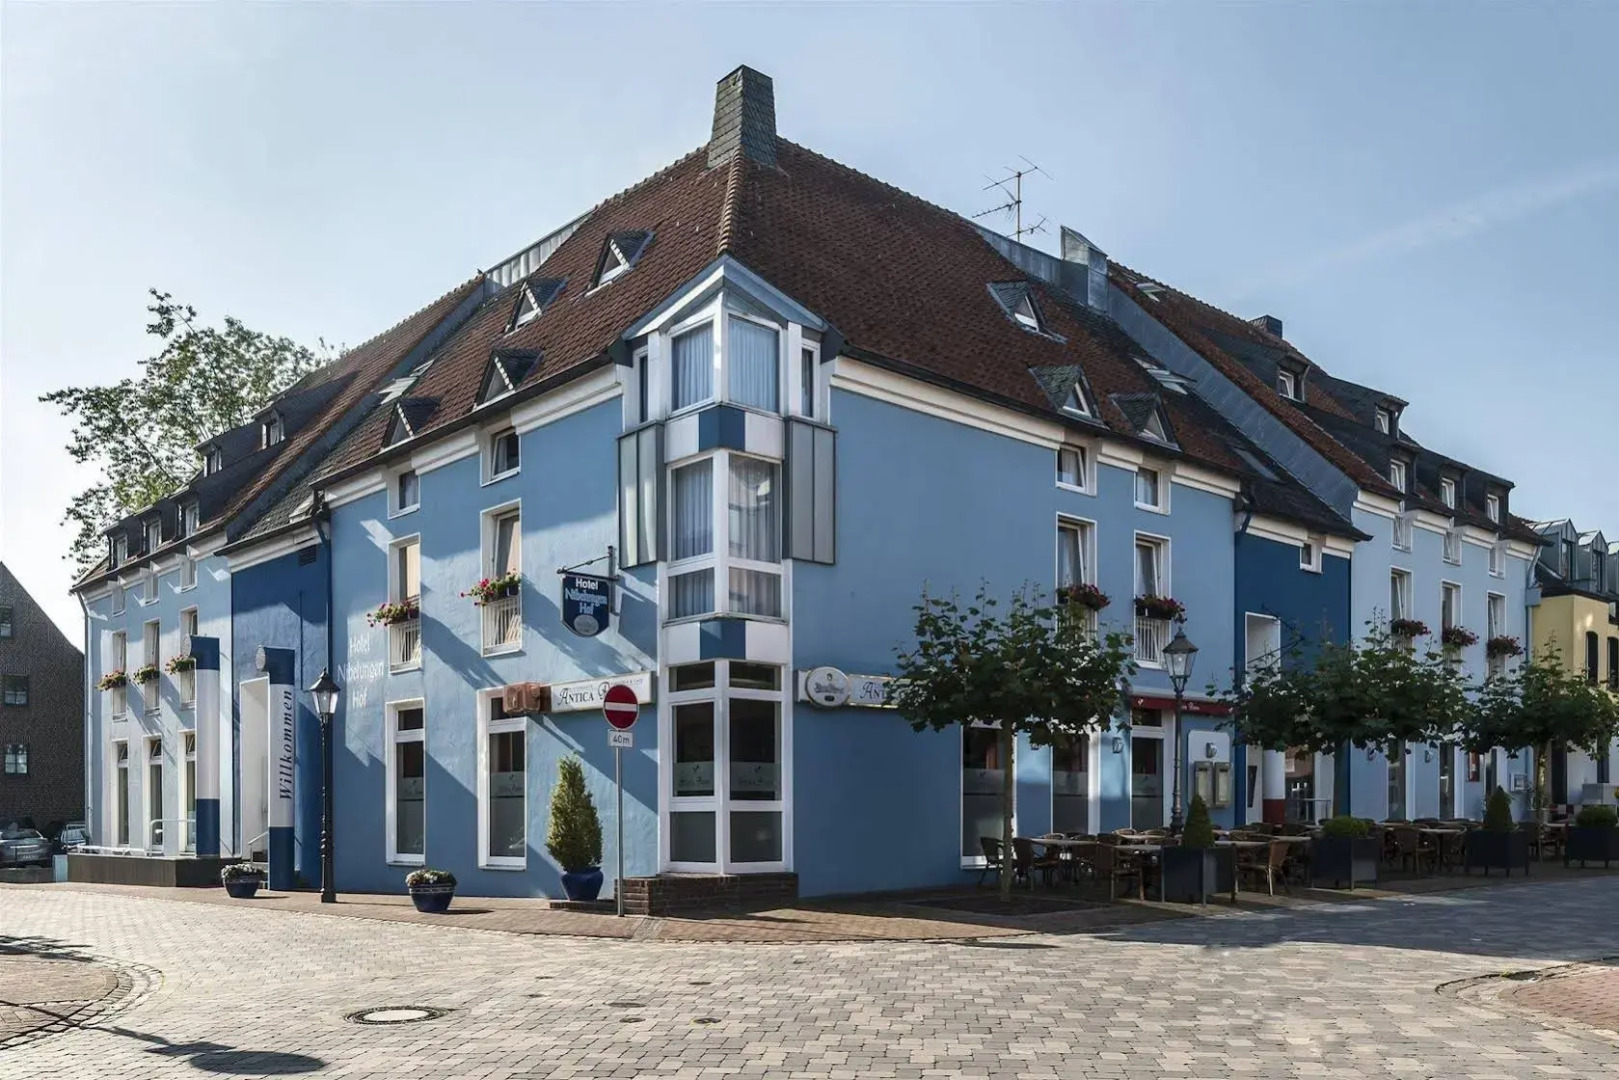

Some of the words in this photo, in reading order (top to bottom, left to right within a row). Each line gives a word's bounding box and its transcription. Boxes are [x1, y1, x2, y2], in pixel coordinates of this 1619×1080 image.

[575, 578, 599, 590] Hotel
[579, 602, 594, 615] Hof
[349, 632, 370, 654] Hotel
[352, 687, 368, 709] Hof
[557, 687, 595, 706] ANTICA
[279, 690, 293, 800] Willkommen
